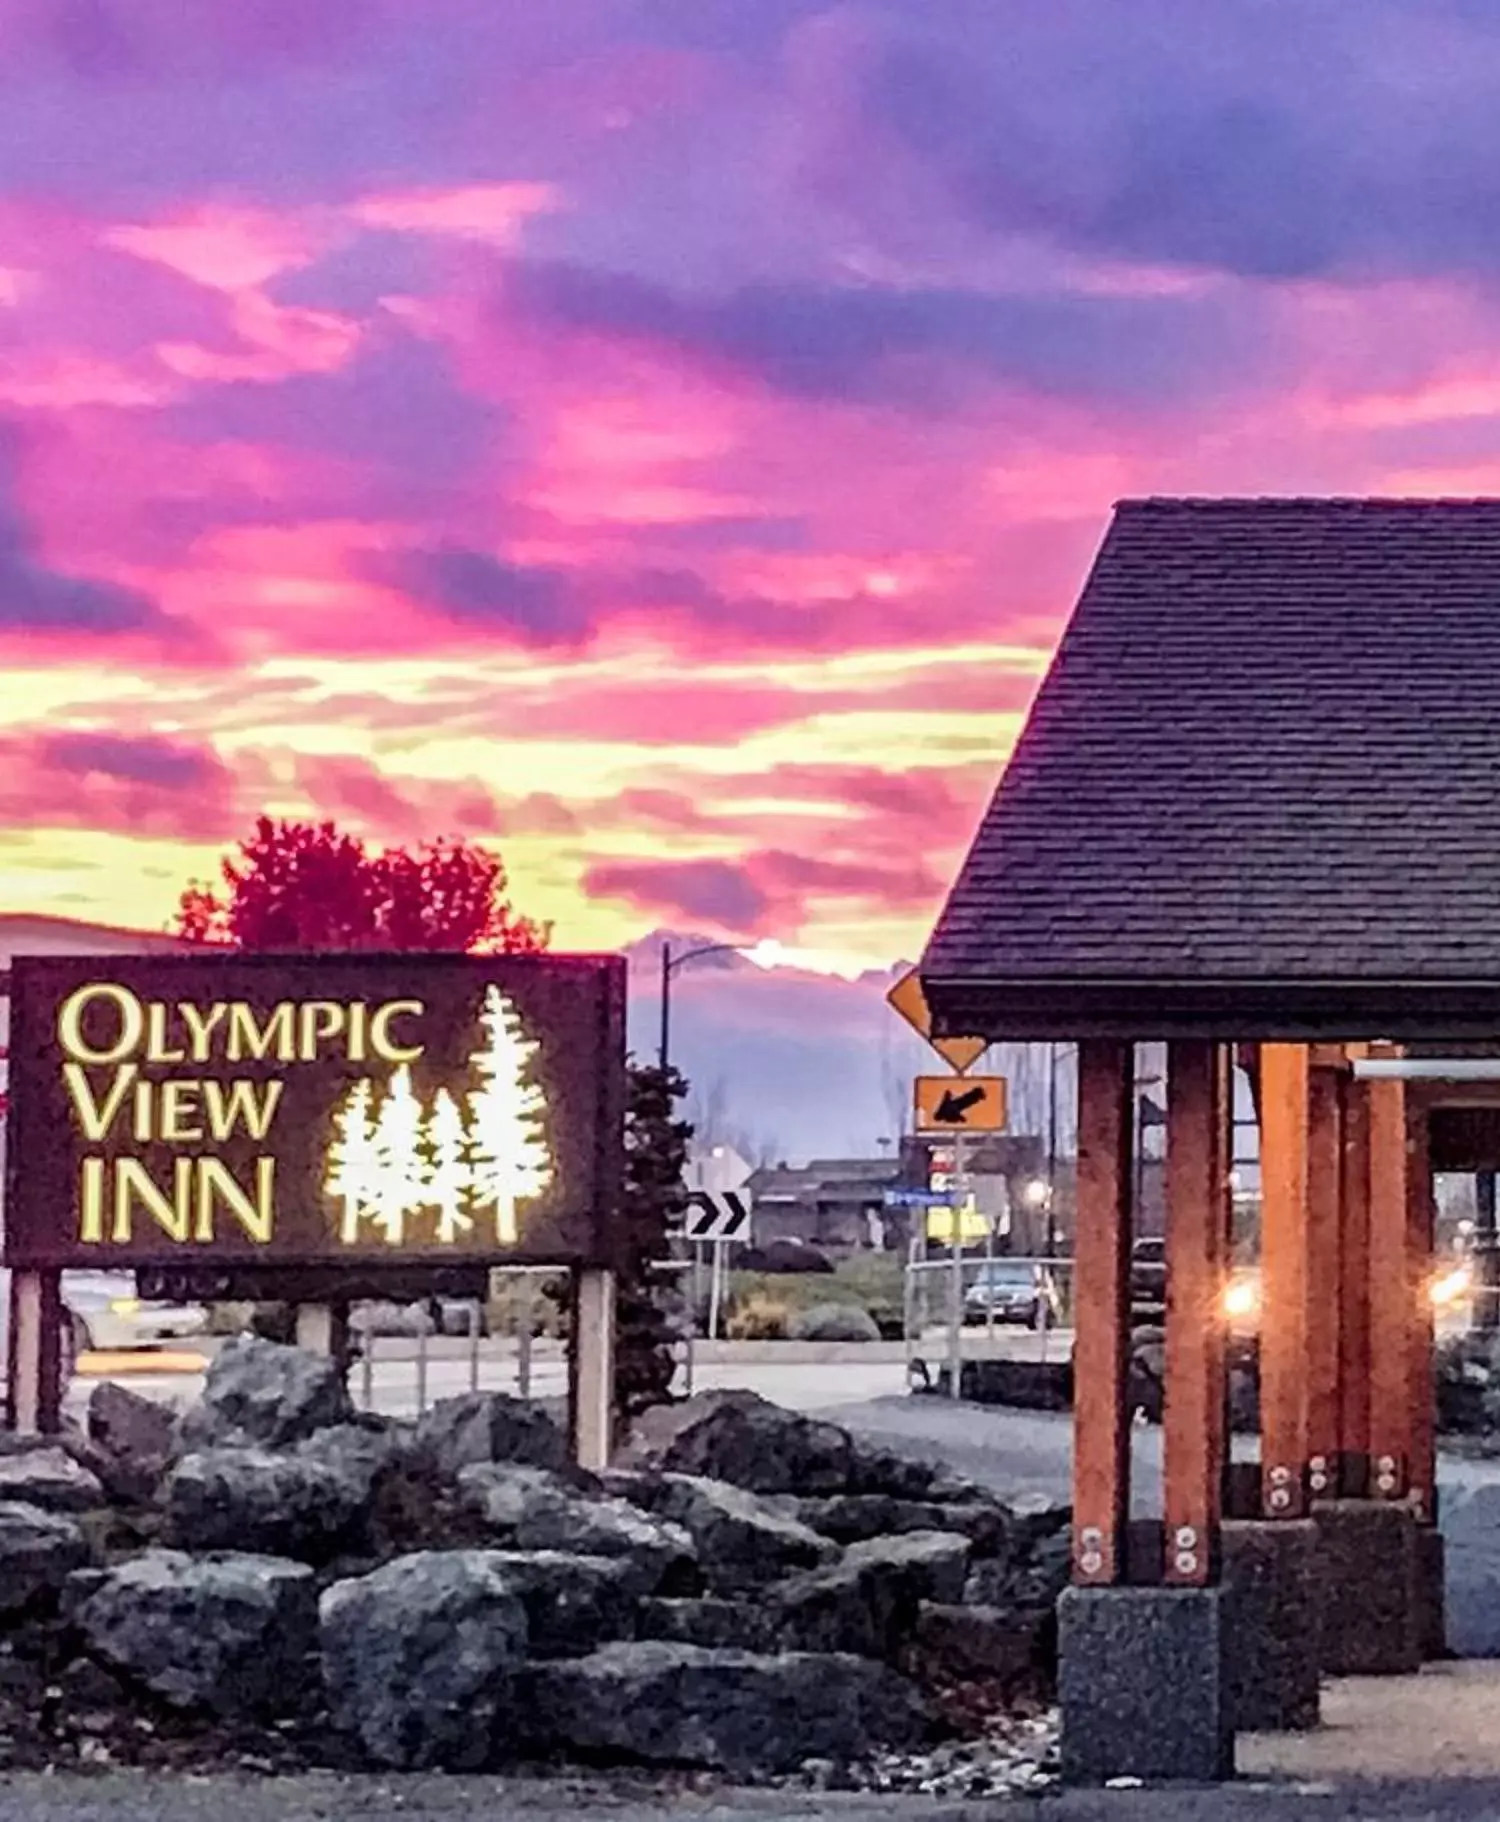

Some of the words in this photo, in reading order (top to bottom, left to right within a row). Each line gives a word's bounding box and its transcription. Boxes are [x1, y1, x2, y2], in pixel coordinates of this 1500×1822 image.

[60, 984, 424, 1062] OLYMPIC
[63, 1063, 283, 1141] VIEW
[81, 1157, 275, 1243] INN
